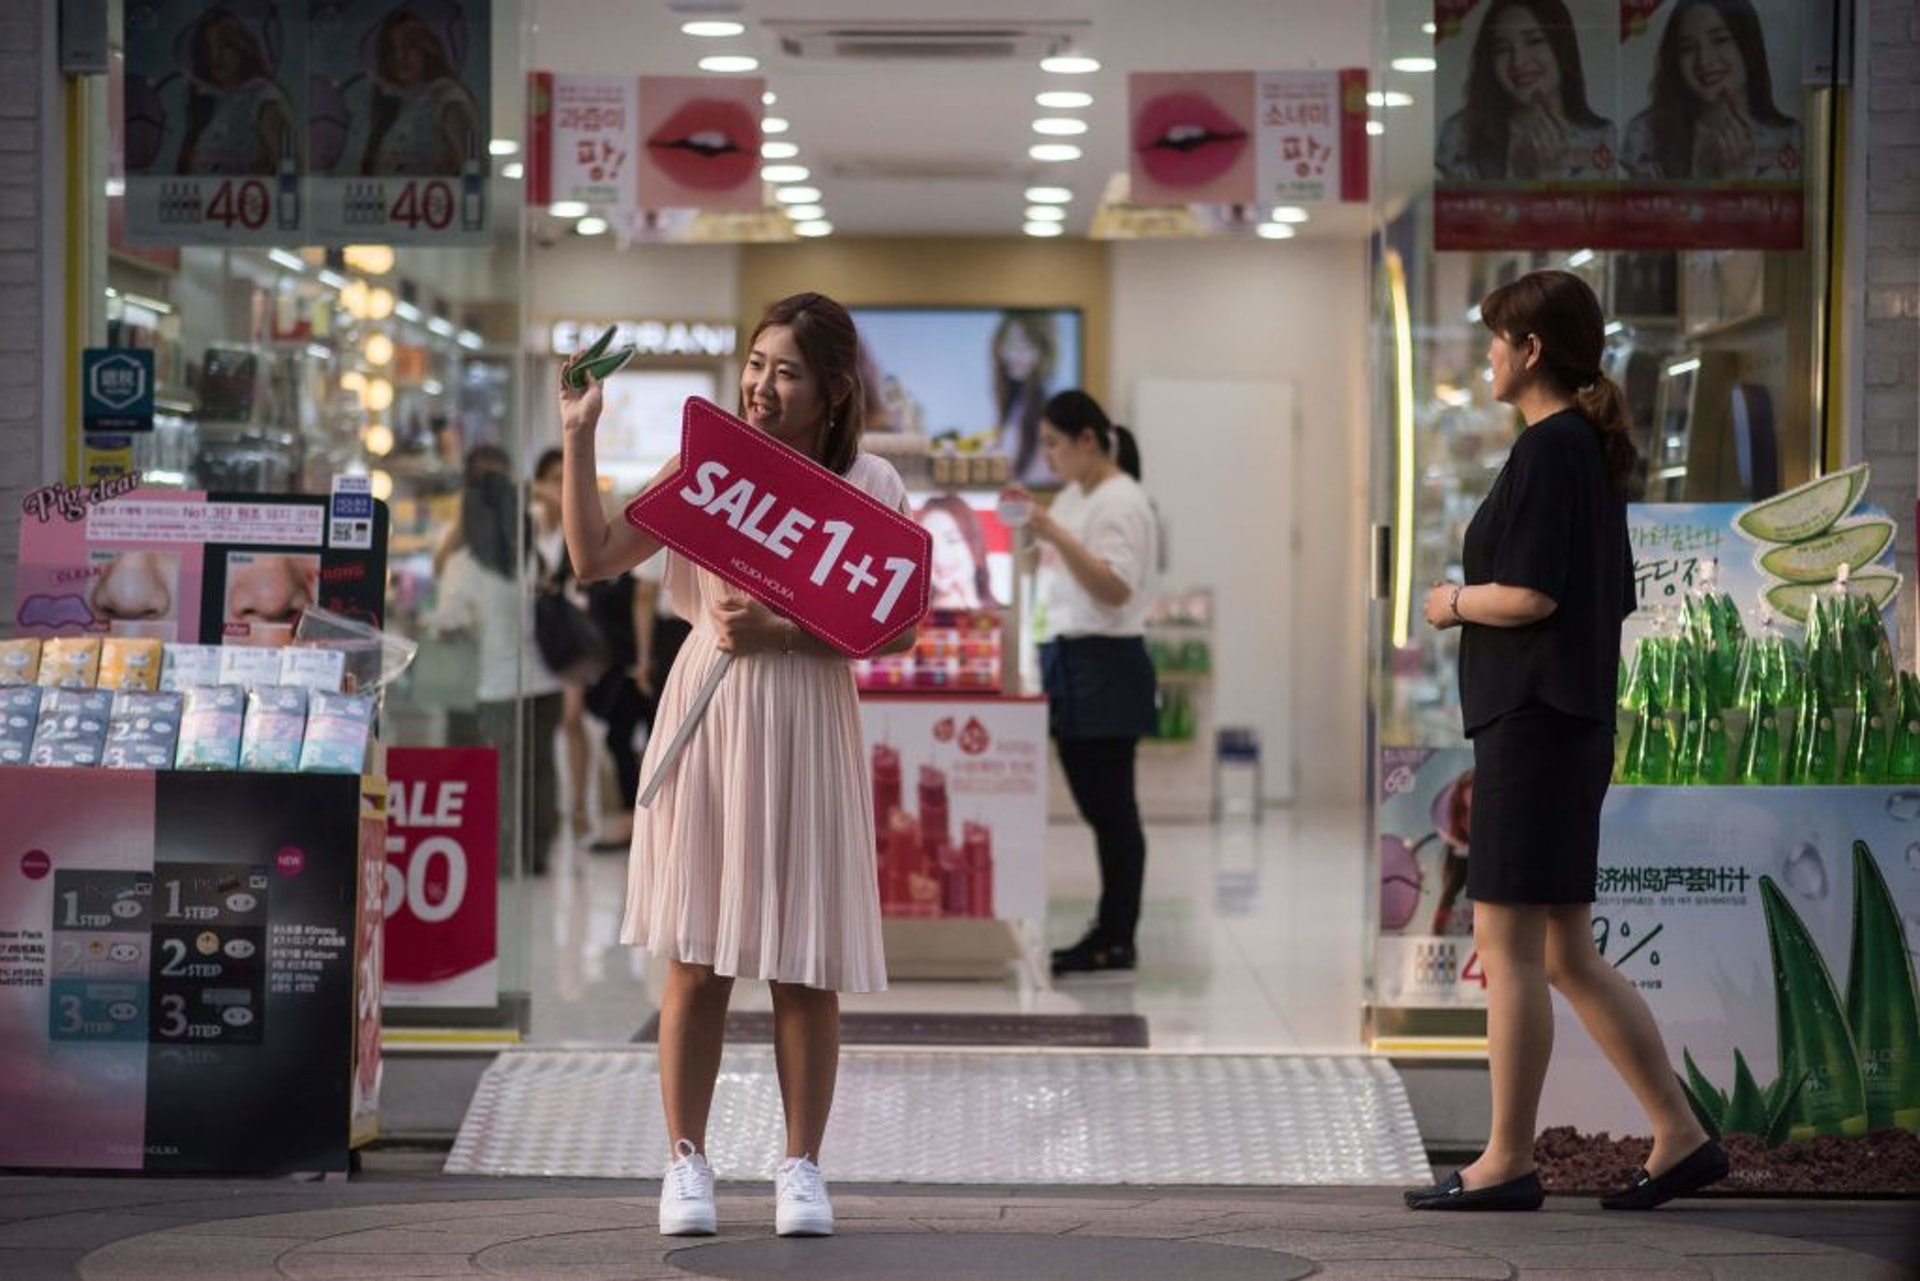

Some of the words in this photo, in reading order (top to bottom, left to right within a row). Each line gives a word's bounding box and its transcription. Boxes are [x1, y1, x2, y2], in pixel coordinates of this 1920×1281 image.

[206, 181, 270, 229] 40
[390, 181, 454, 229] 40
[22, 483, 88, 522] Pig
[89, 469, 141, 504] clear
[679, 460, 816, 560] SALE
[809, 520, 917, 624] 1+1
[730, 556, 763, 581] HOLIKA
[762, 575, 795, 601] HOLIKA
[62, 890, 80, 927] 1
[80, 914, 112, 927] STEP
[164, 879, 182, 918] 1
[183, 905, 220, 920] STEP
[161, 938, 187, 977] 2
[187, 963, 223, 978] STEP
[59, 995, 83, 1033] 3
[159, 993, 188, 1037] 3
[187, 1024, 222, 1039] STEP
